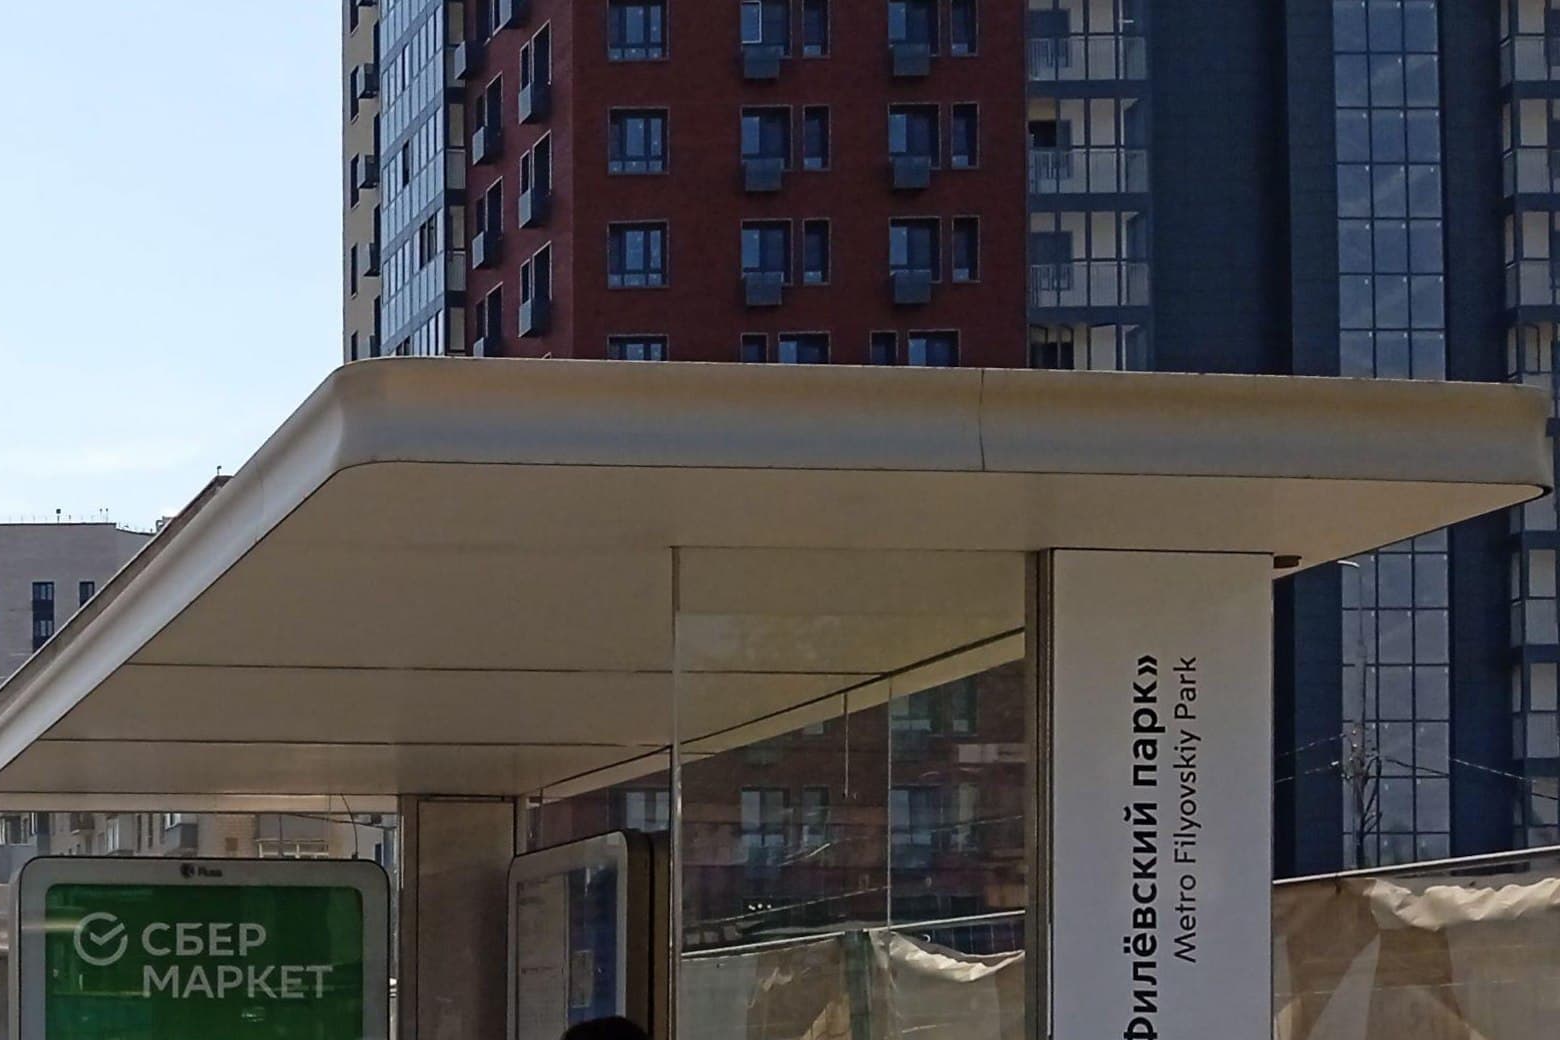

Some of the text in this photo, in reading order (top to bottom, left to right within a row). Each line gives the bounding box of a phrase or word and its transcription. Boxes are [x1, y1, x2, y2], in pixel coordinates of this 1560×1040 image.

[1132, 655, 1166, 786] парк»
[1173, 657, 1201, 963] Metro Filyovskiy Park
[142, 922, 267, 956] СБЕР
[143, 965, 333, 998] МАРКЕТ
